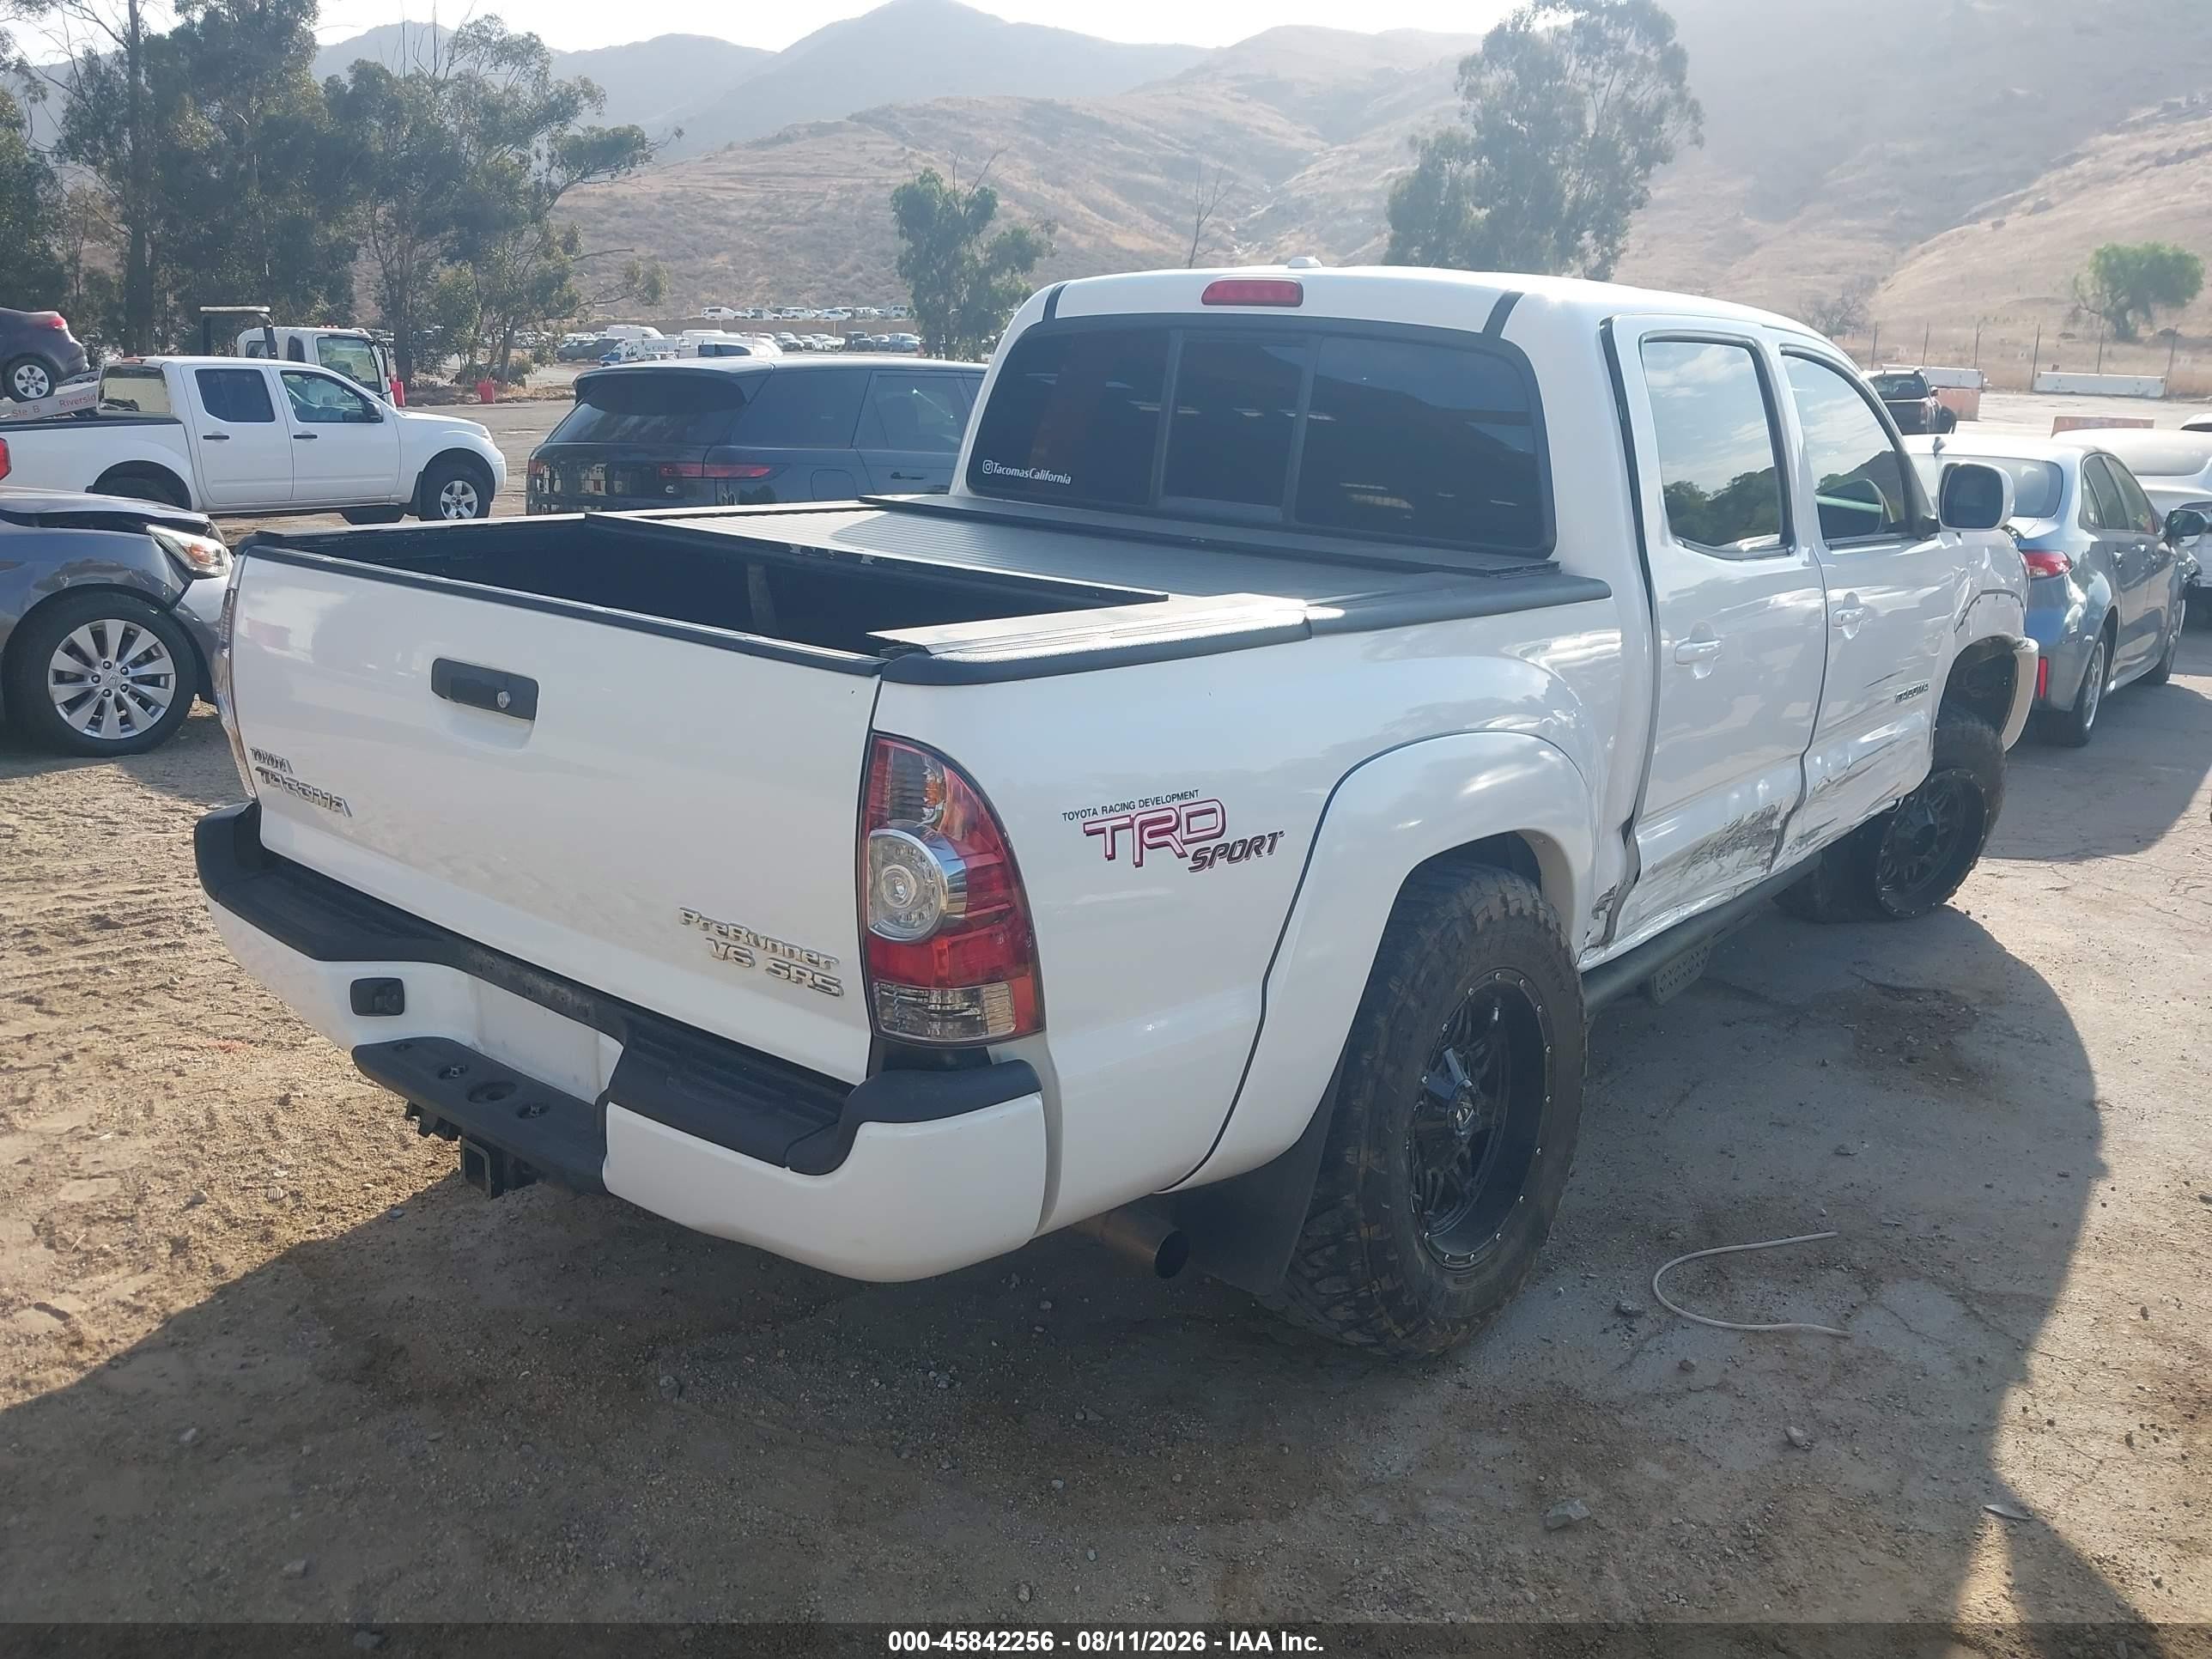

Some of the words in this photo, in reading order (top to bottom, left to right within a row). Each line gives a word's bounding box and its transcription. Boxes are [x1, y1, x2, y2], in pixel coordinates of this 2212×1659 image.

[33, 404, 40, 413] B
[993, 462, 1072, 484] TacomasCalifornia
[249, 746, 294, 774] TOYOTA
[1061, 808, 1098, 822] TOYOTA
[1101, 800, 1135, 815] RACING
[1138, 789, 1200, 808] DEVELOPMENT
[1083, 799, 1226, 868] TRD
[1188, 830, 1285, 872] SPORT
[679, 906, 840, 970] PreRunner
[706, 937, 757, 968] V6
